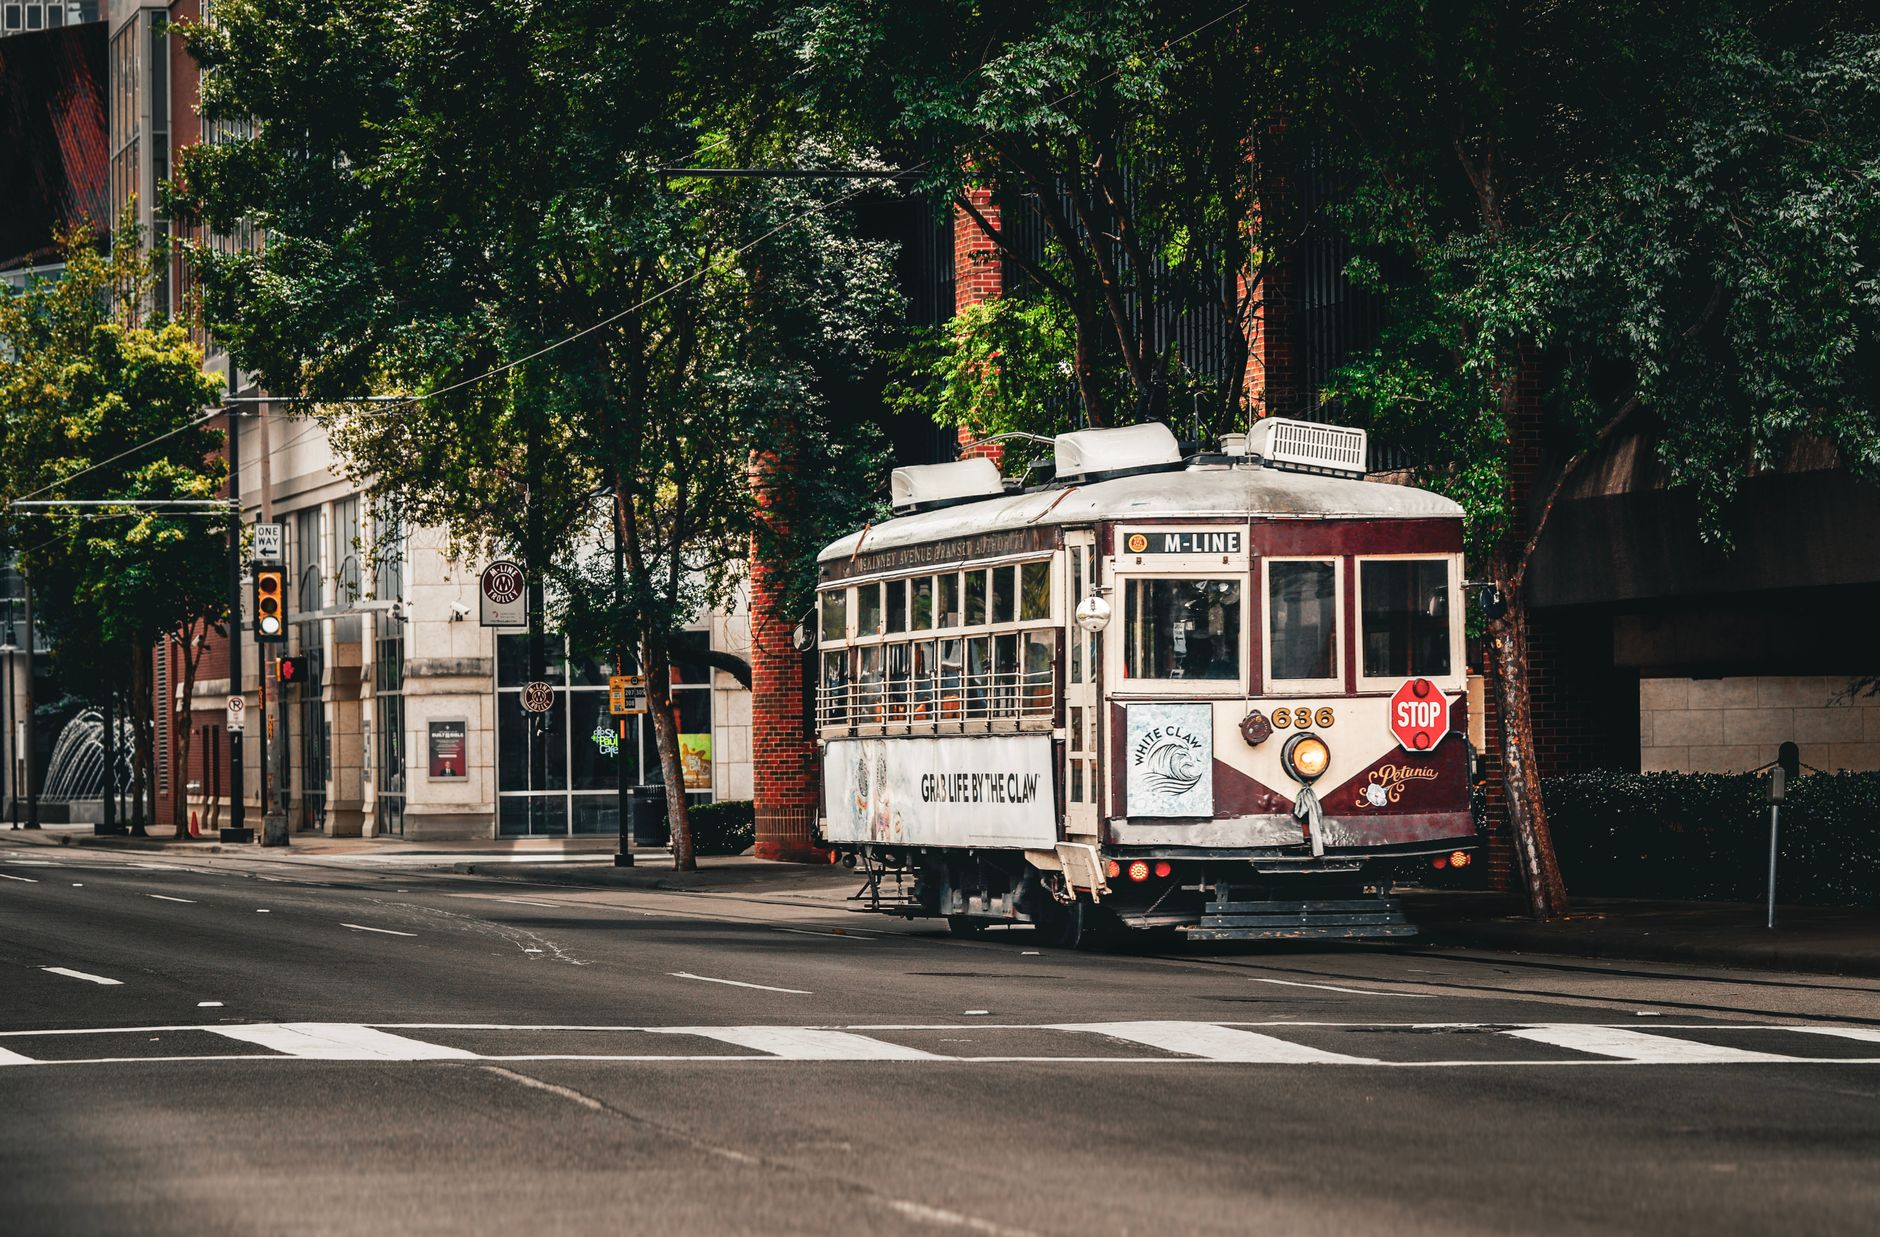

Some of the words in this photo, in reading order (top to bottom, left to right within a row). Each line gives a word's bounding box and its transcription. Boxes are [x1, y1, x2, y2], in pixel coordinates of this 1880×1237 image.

[258, 527, 278, 536] ONE
[258, 537, 278, 546] WAY
[1164, 533, 1238, 553] M-LINE
[899, 546, 932, 565] AVENUE
[489, 564, 519, 577] M-LINE
[487, 589, 519, 603] TROLLEY
[1271, 707, 1335, 729] 636
[1397, 701, 1441, 728] STOP
[600, 734, 618, 746] Paul
[605, 728, 615, 738] St
[1135, 728, 1162, 766] WHITE
[1165, 726, 1202, 750] CLAW
[1378, 764, 1439, 787] Petunia
[921, 773, 947, 803] GRAB
[948, 773, 969, 803] LIFE
[972, 773, 984, 803] BY
[985, 773, 1006, 804] THE
[1007, 773, 1038, 804] CLAW
